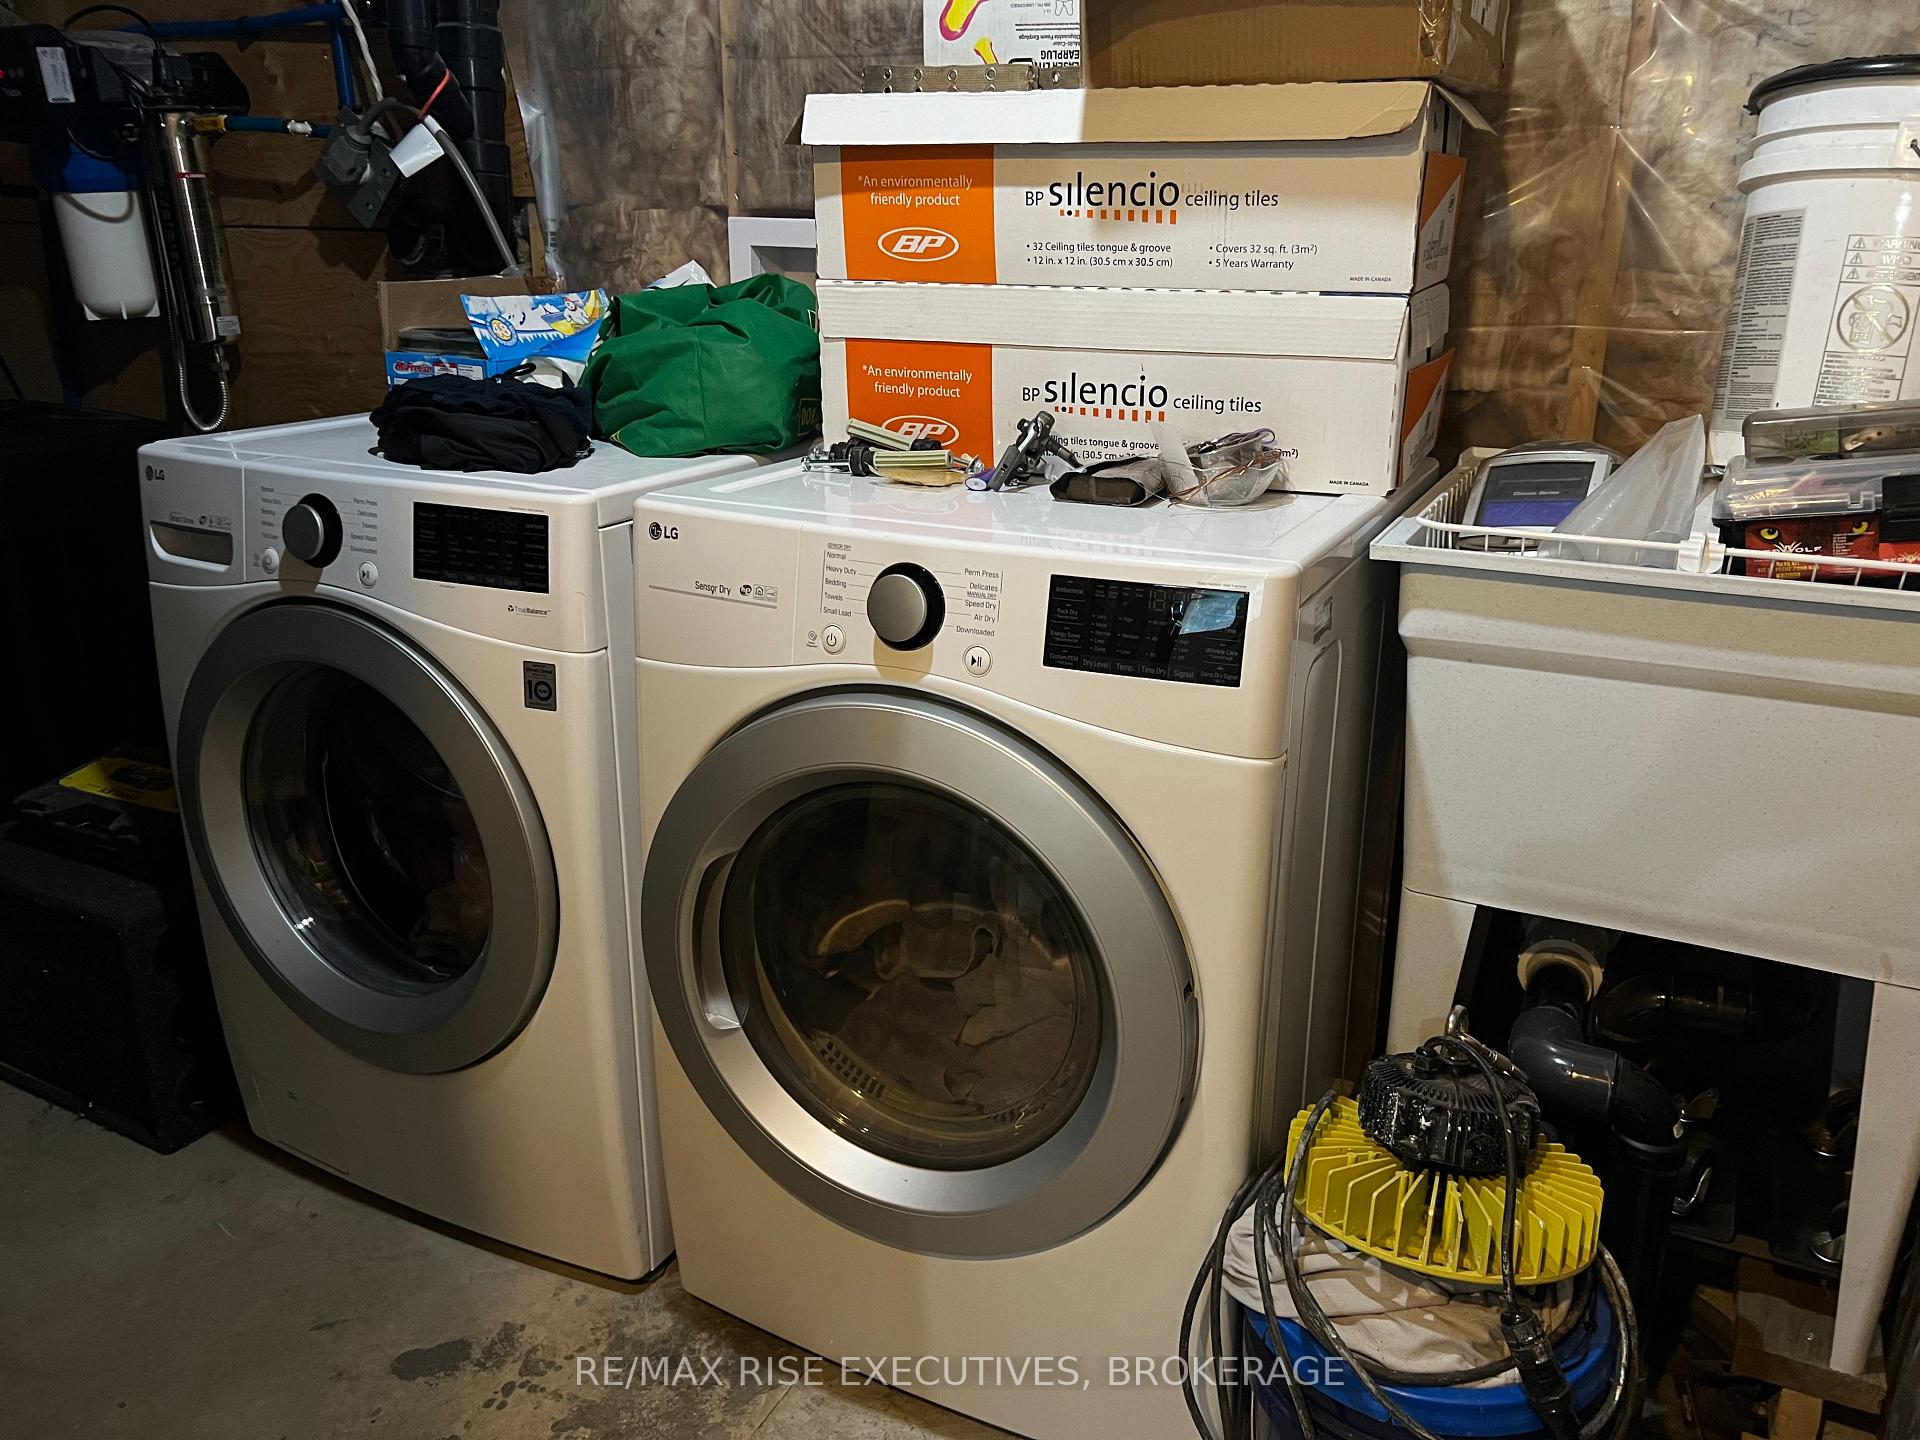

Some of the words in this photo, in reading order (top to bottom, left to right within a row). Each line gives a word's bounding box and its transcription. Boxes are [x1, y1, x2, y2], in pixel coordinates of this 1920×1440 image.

[1040, 50, 1080, 60] EARPLUG
[881, 175, 973, 190] environmentally
[1026, 191, 1043, 206] BP
[1049, 171, 1180, 213] silencio
[1186, 190, 1239, 210] ceiling
[1245, 190, 1278, 207] tiles
[870, 193, 912, 208] friendly
[915, 193, 960, 208] product
[891, 235, 948, 254] BP
[1033, 243, 1043, 252] 32
[1045, 242, 1075, 254] Ceiling
[1077, 242, 1095, 252] tiles
[1096, 244, 1129, 255] tongue
[1131, 243, 1138, 252] &
[1139, 246, 1172, 256] groove
[1216, 244, 1248, 253] Covers
[1250, 244, 1262, 253] 32
[1264, 246, 1277, 256] sq.
[1280, 244, 1289, 254] ft.
[1033, 256, 1043, 265] 12
[1045, 256, 1056, 265] in.
[1066, 257, 1076, 265] 12
[1078, 256, 1088, 265] in.
[1090, 257, 1111, 268] (30.5
[1135, 258, 1154, 267] 30.5
[1157, 258, 1173, 268] cm)
[1215, 258, 1221, 268] 5
[1223, 259, 1249, 269] Years
[1250, 259, 1295, 272] Warranty
[885, 367, 973, 385] environmentally
[874, 382, 915, 398] friendly
[917, 385, 961, 399] product
[1021, 387, 1039, 402] BP
[1043, 372, 1168, 411] silencio
[1172, 394, 1224, 415] ceiling
[1229, 396, 1261, 413] tiles
[896, 422, 948, 440] BP
[1071, 436, 1088, 446] tiles
[1089, 438, 1120, 450] tongue
[1121, 439, 1128, 448] &
[1129, 442, 1160, 451] groove
[1083, 450, 1102, 460] (30.5
[826, 551, 847, 560] Normal
[826, 564, 844, 575] Heavy
[844, 567, 857, 577] Duty
[964, 568, 981, 577] Perm
[981, 570, 1000, 579] Press
[695, 580, 718, 595] Sensor
[719, 584, 732, 597] Dry
[825, 578, 848, 589] Bedding
[969, 582, 999, 593] Delicates
[824, 592, 844, 602] Towels
[823, 606, 838, 616] Small
[838, 608, 852, 617] Load
[964, 600, 985, 609] Speed
[985, 602, 997, 611] Dry
[984, 615, 996, 624] Dry
[956, 625, 995, 637] Downloaded
[1083, 658, 1093, 668] Dry
[1093, 659, 1109, 668] Level
[1156, 667, 1167, 676] Dry
[1173, 669, 1194, 679] Signal
[527, 679, 553, 702] 10
